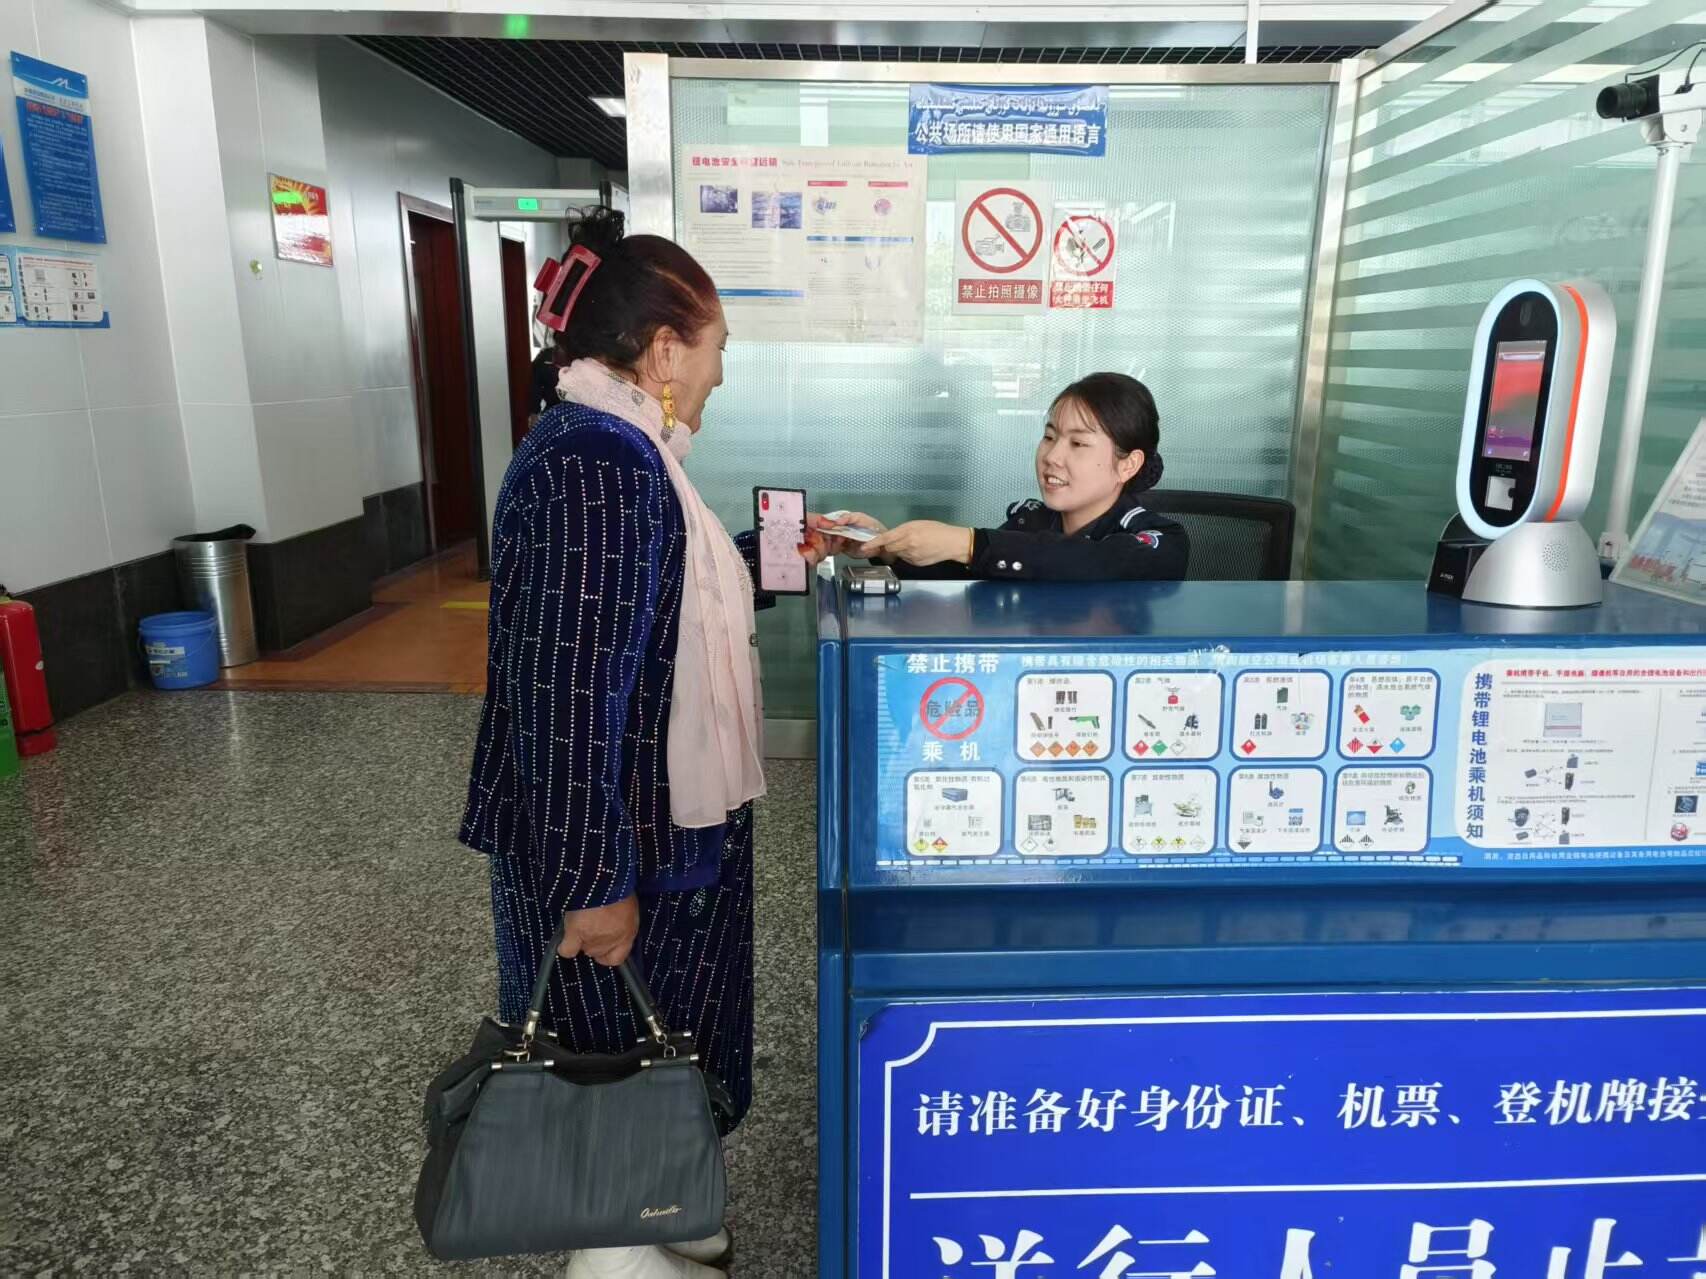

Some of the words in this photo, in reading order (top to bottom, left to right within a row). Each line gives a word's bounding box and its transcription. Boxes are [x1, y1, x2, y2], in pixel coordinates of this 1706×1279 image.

[915, 121, 1101, 145] 公共场所请使用国家通用语言
[962, 284, 1040, 299] 禁止拍照摄像
[906, 653, 1000, 674] 禁止携带
[927, 700, 980, 718] 危险品
[922, 741, 981, 762] 乘机
[1466, 673, 1493, 840] 携带锂电池乘机须知
[913, 1076, 1706, 1137] 请准备好身份证、机票、登机牌接
